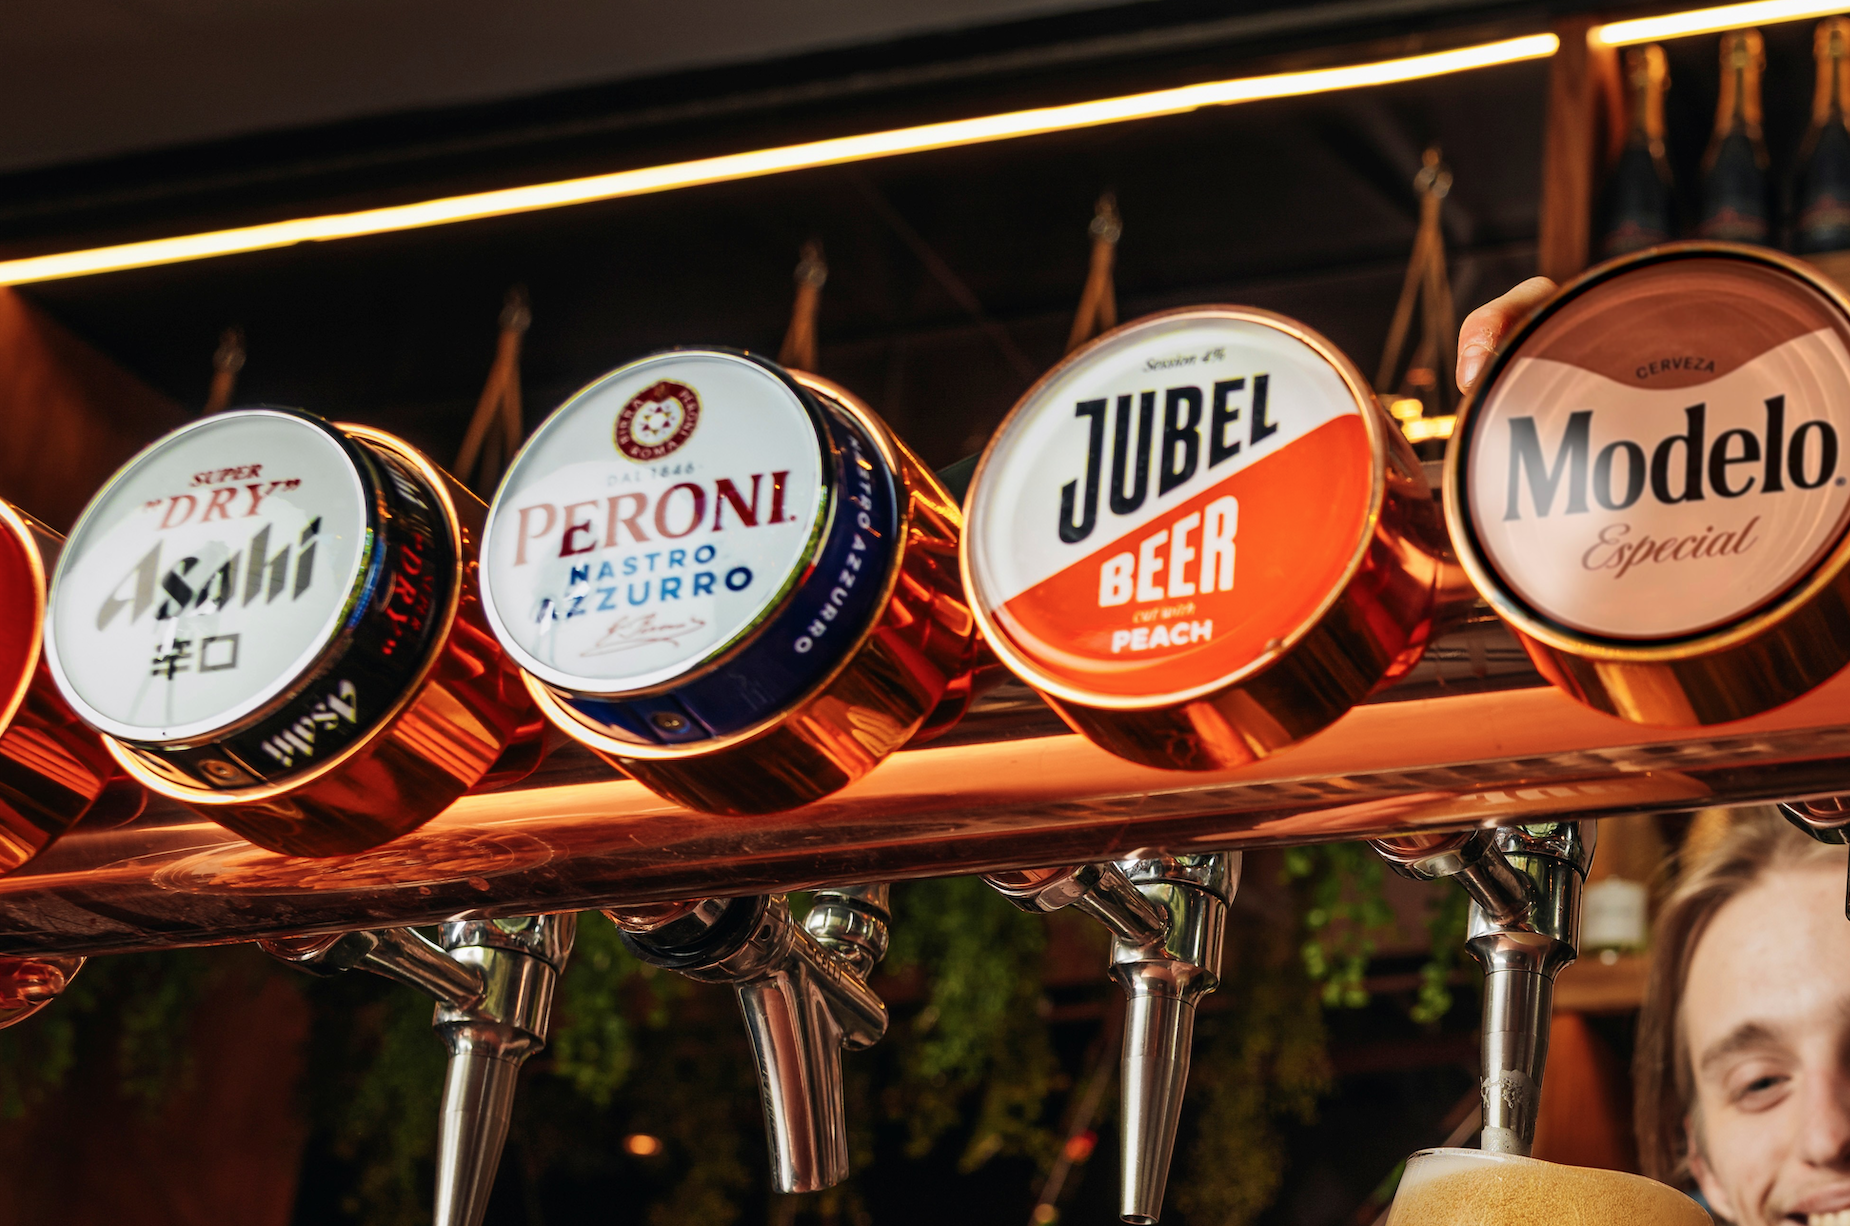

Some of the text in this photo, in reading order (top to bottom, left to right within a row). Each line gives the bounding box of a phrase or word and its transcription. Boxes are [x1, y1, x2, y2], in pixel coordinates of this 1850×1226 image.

[1635, 356, 1716, 380] CERVEZA
[190, 463, 263, 488] SUPER
[629, 440, 679, 460] ROMA
[1058, 373, 1278, 544] JUBEL
[1502, 394, 1838, 522] Modelo
[512, 471, 789, 568] PERONI
[1099, 495, 1240, 608] BEER
[1582, 515, 1761, 580] Especial
[96, 516, 322, 631] Asahi
[535, 566, 754, 624] AZZURRO
[570, 544, 717, 586] NASTRO
[794, 532, 868, 654] AZZURRO
[1111, 618, 1214, 654] PEACH
[260, 679, 357, 768] Asahi
